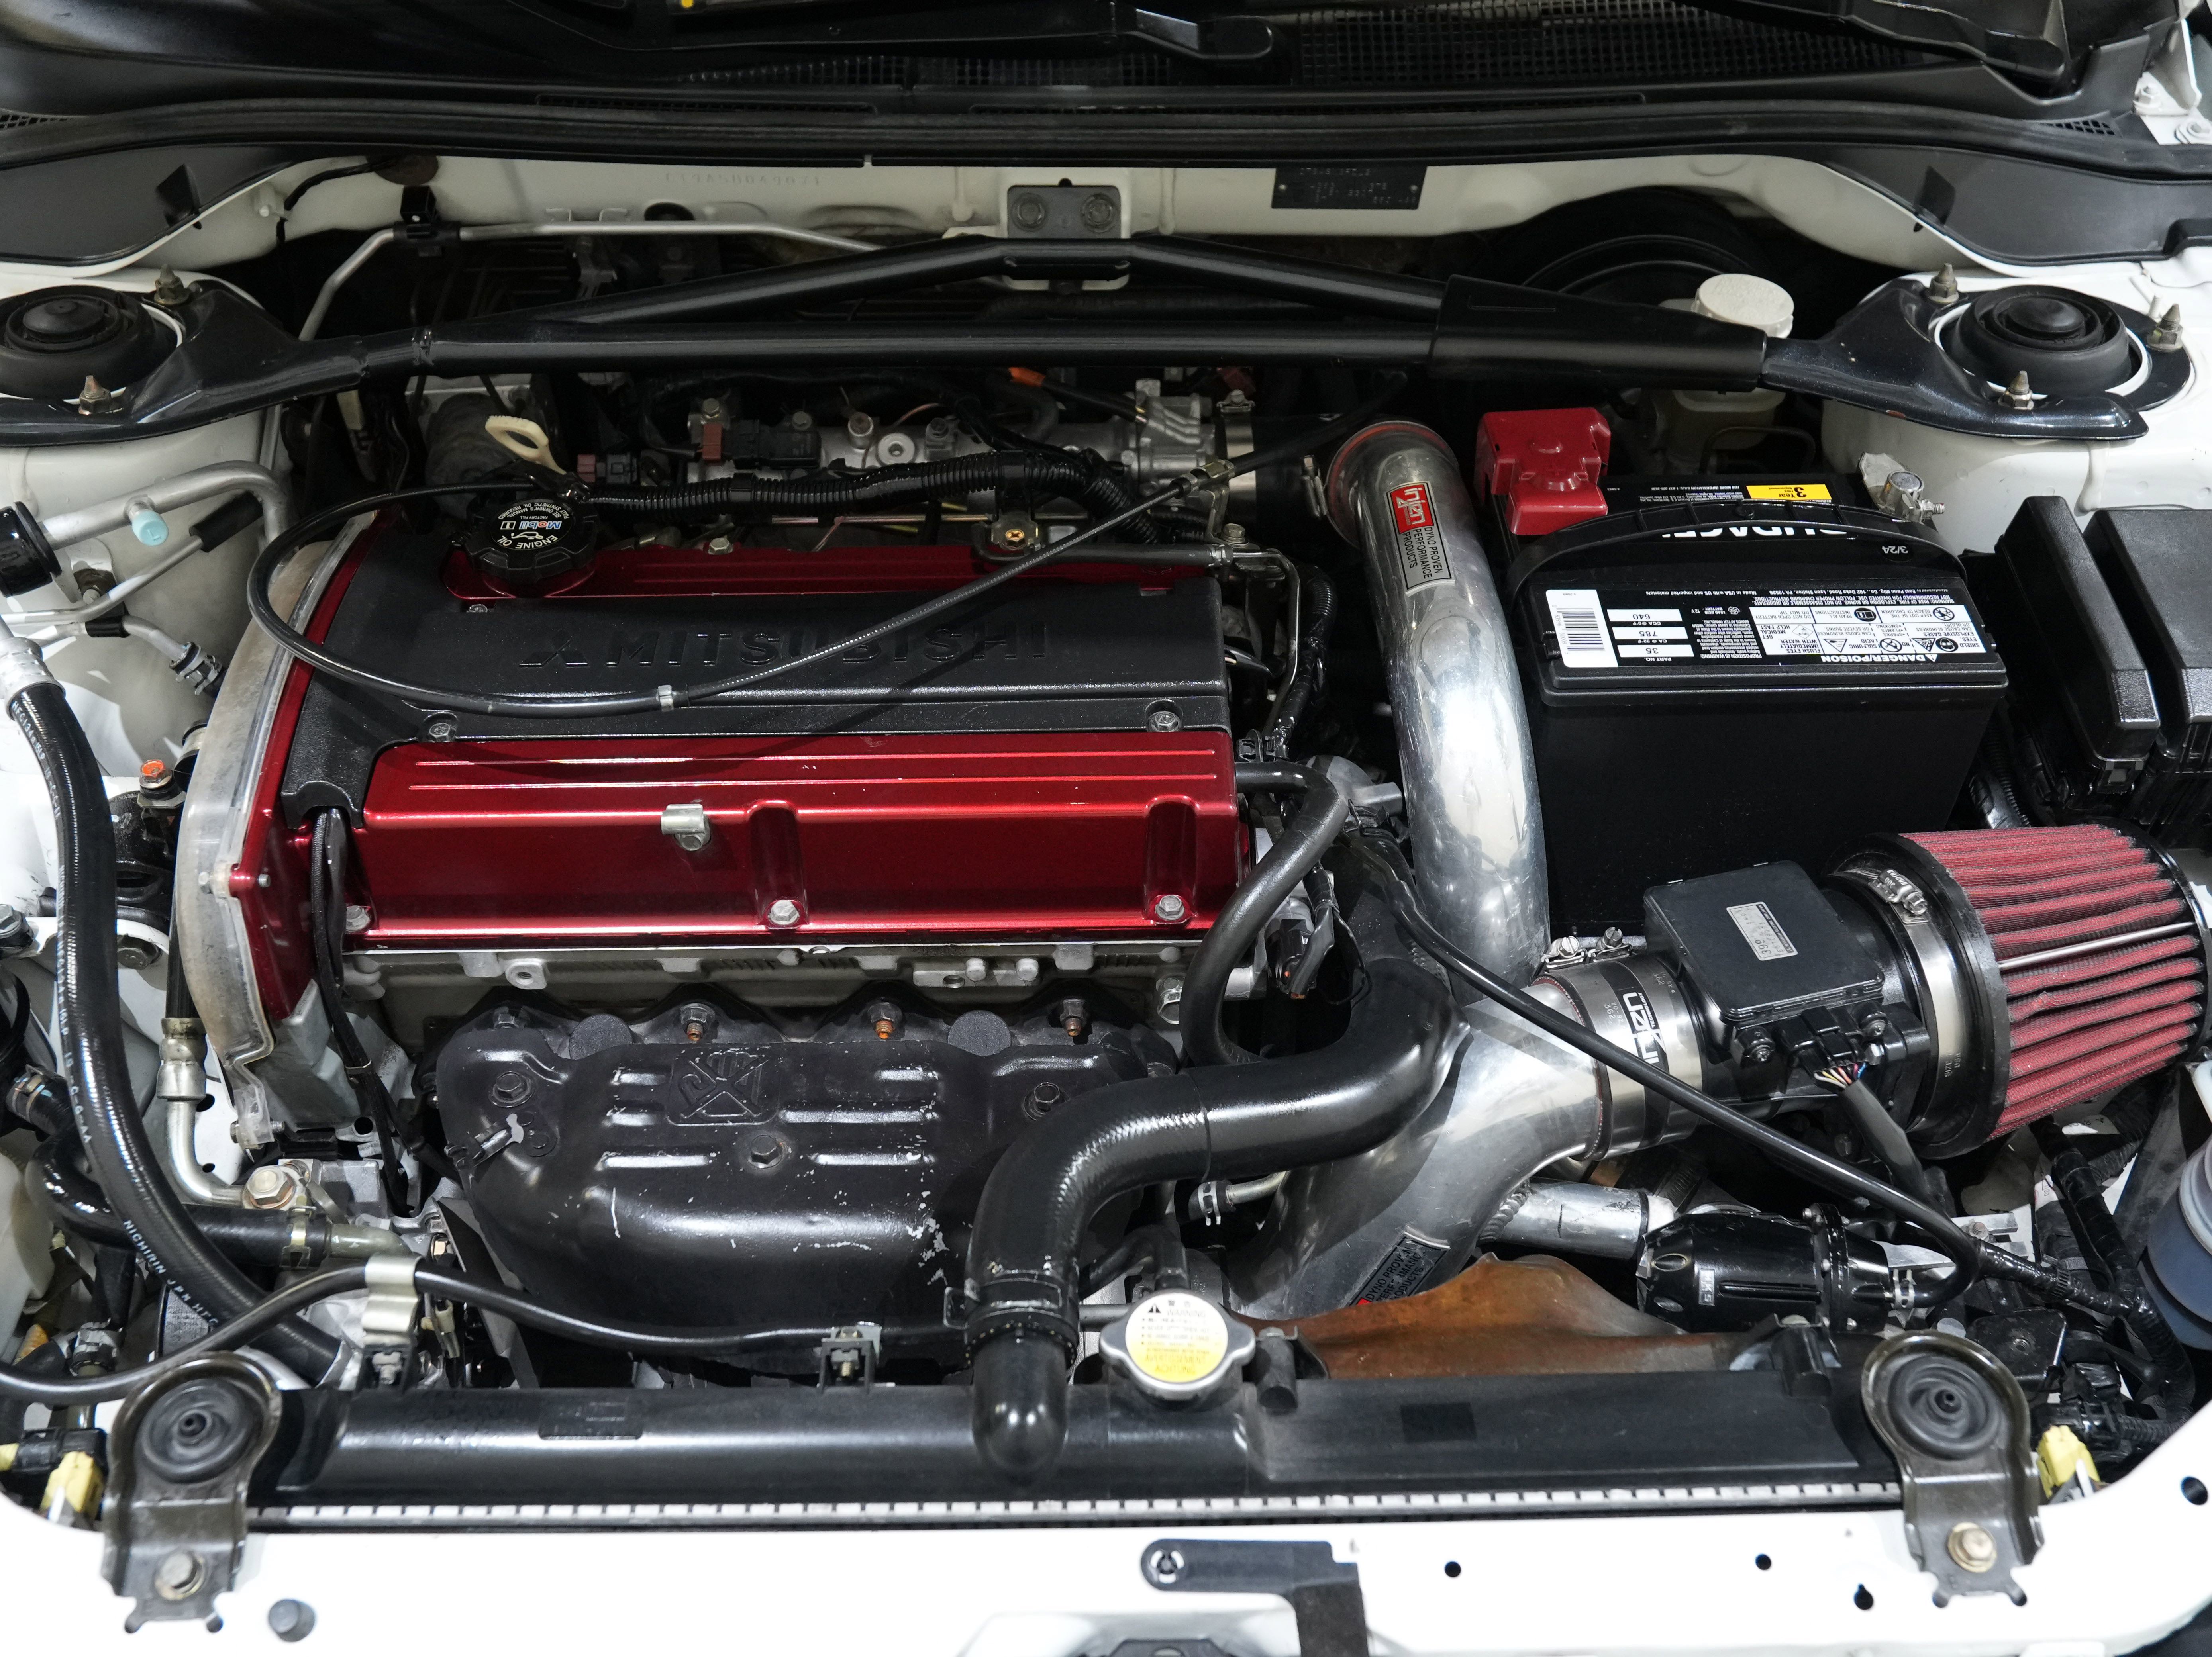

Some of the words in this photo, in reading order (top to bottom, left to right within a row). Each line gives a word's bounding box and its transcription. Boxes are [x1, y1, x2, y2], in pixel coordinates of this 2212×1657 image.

[1794, 487, 1806, 497] 3
[498, 506, 521, 519] REQUIRED
[506, 507, 528, 518] MANUAL
[559, 509, 570, 519] FULLY
[519, 521, 562, 529] Mobil
[497, 536, 512, 546] OIL
[515, 535, 558, 549] ENGINE
[1402, 532, 1418, 568] PRODUCTS
[1413, 529, 1432, 579] PERFORMANCE
[1424, 527, 1436, 544] DYNO
[1430, 546, 1443, 573] PROVEN
[1881, 545, 1908, 554] 3/24
[1755, 939, 1771, 954] 399
[1604, 1004, 1616, 1020] 362
[1637, 992, 1656, 1028] TECHNOLOGY
[1953, 1051, 1961, 1069] USA
[124, 1220, 167, 1274] NICHIRIN
[1365, 1278, 1387, 1300] DYNO
[1383, 1247, 1413, 1278] PROVN
[1700, 1271, 1714, 1303] HKS
